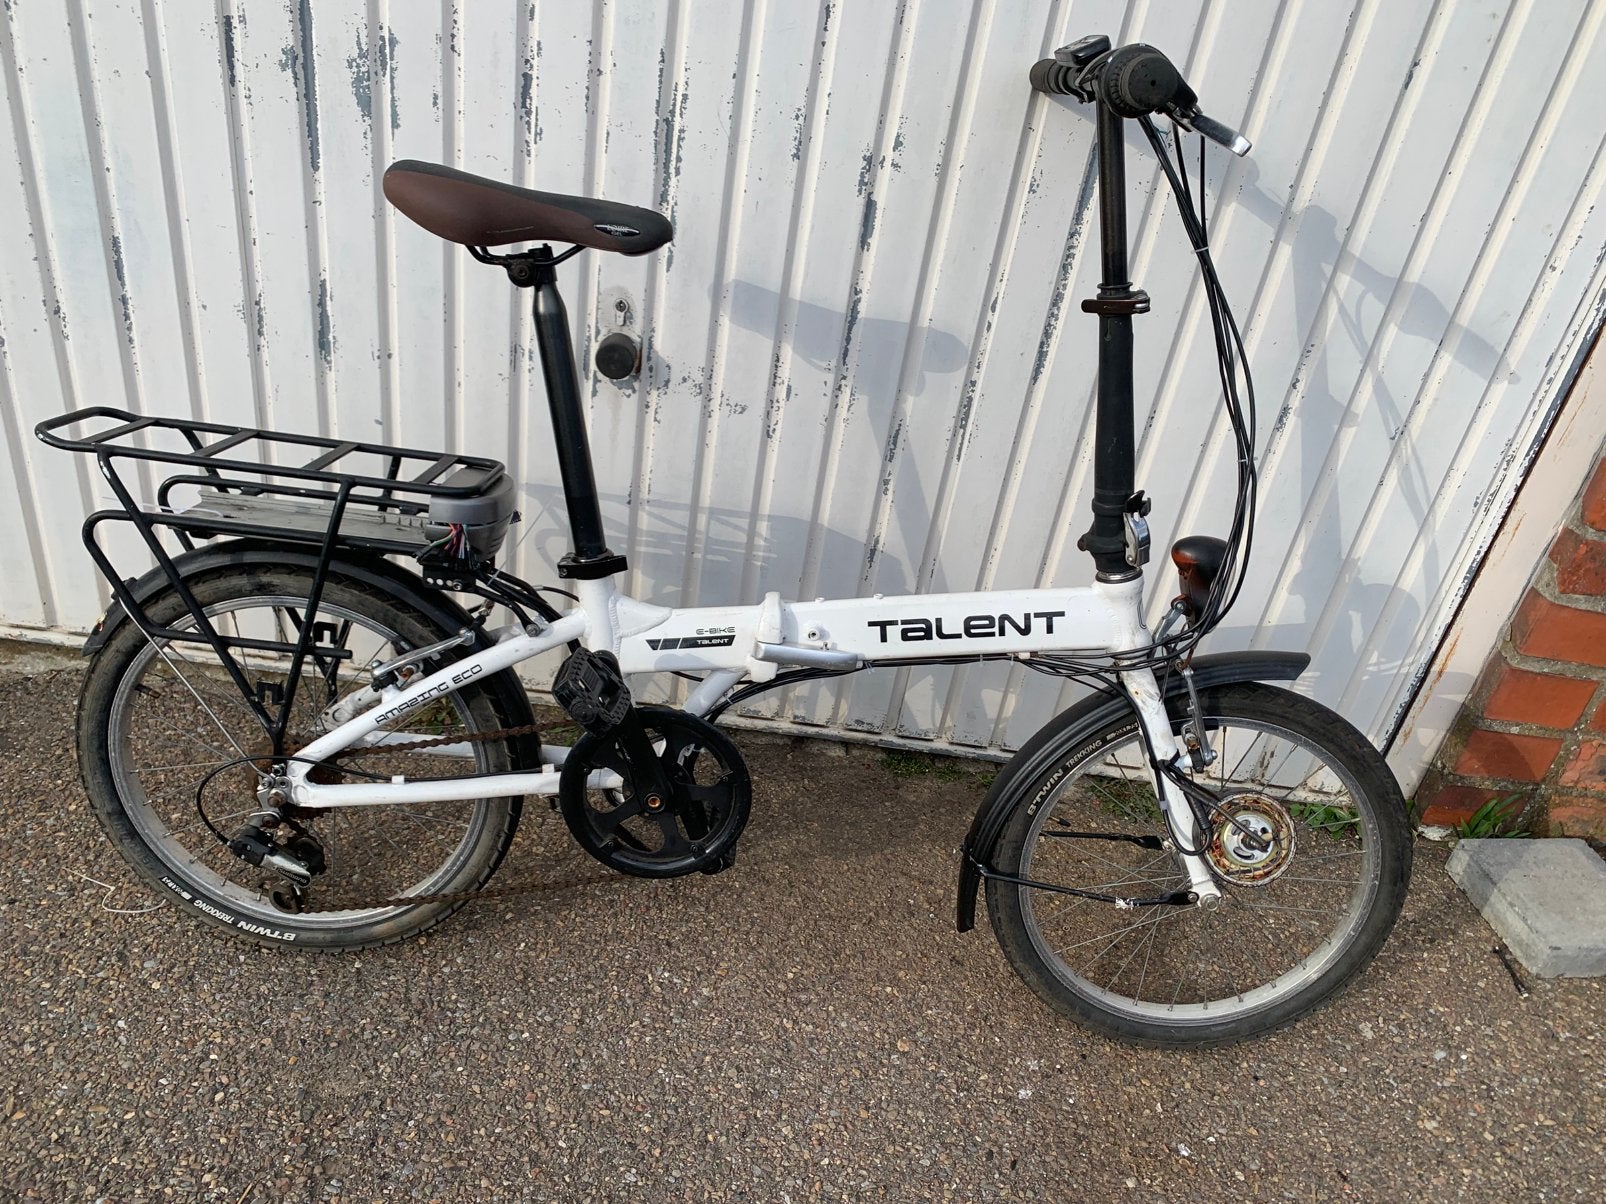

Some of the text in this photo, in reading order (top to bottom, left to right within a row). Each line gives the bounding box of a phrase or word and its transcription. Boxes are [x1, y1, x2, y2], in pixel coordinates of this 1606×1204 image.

[695, 626, 736, 635] E-BIKE
[374, 663, 483, 725] AMAZING ECO
[1026, 739, 1103, 816] B'TWIN TREKKING
[193, 899, 297, 942] B'TWIN TREKKING
